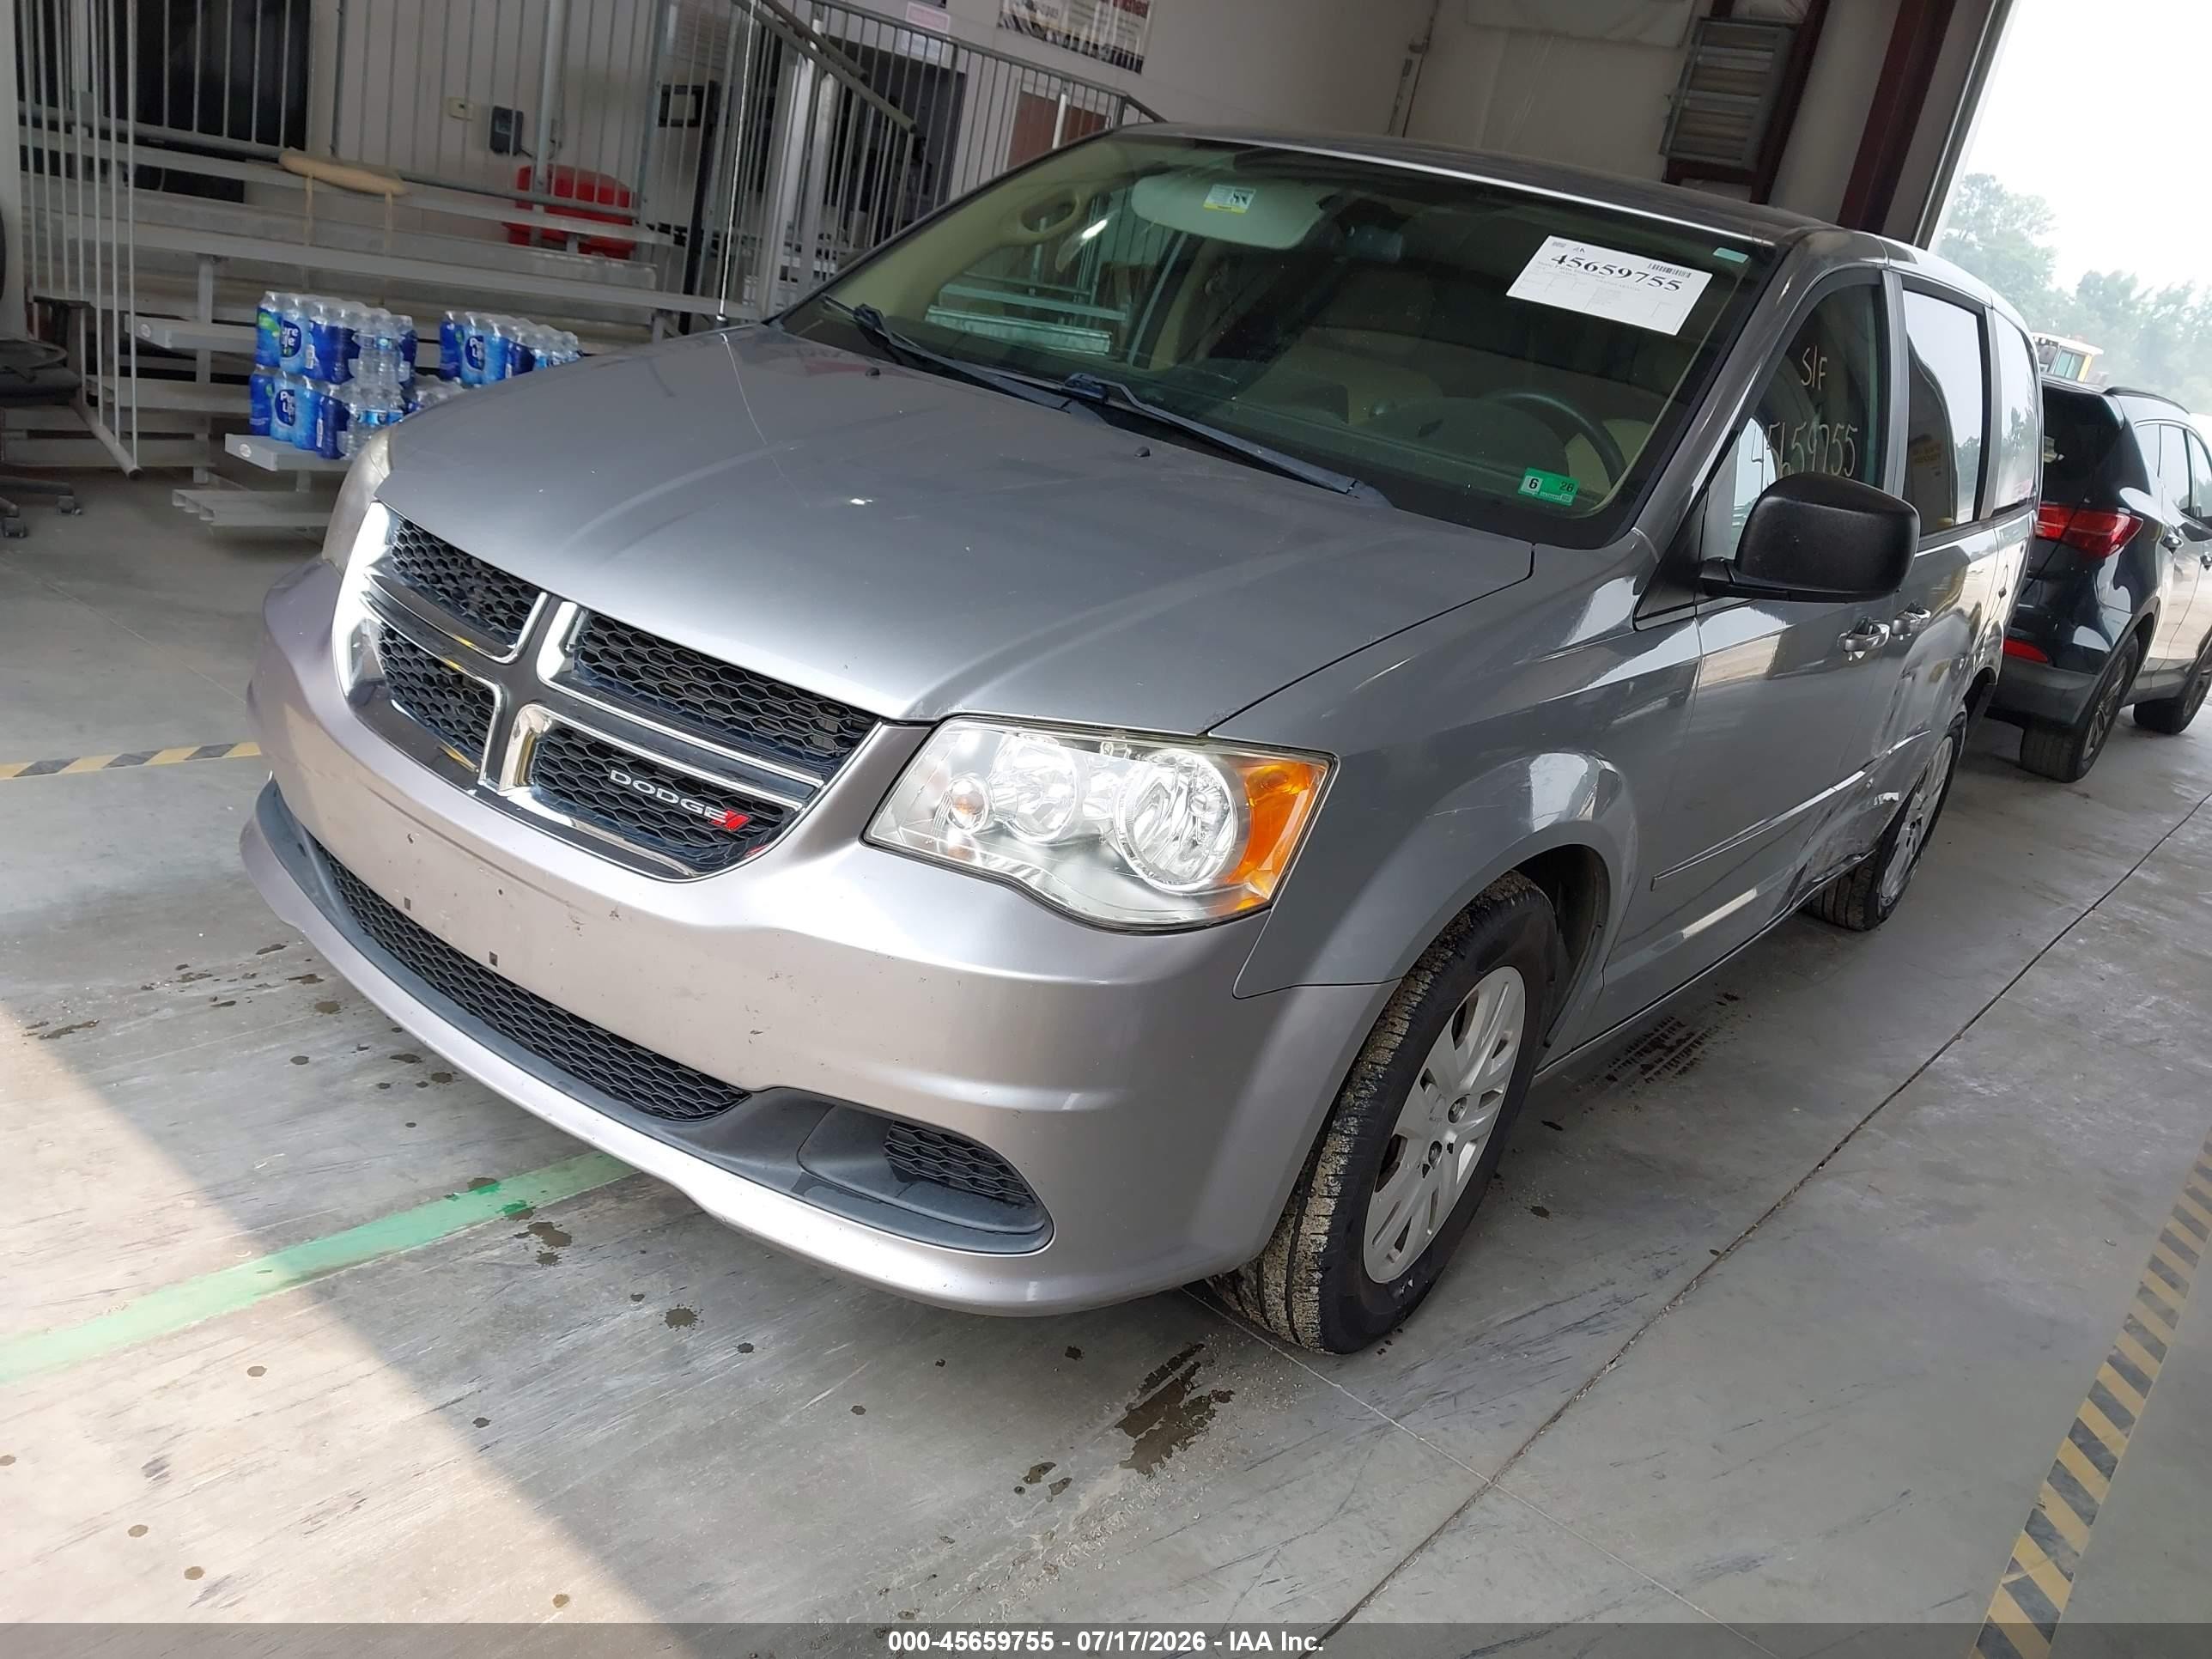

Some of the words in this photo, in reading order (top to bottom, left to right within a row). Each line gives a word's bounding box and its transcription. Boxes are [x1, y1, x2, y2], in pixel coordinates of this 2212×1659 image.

[1551, 254, 1683, 292] 45659755
[1528, 477, 1539, 489] 6
[1559, 481, 1575, 493] 26
[610, 769, 728, 824] DODGE
